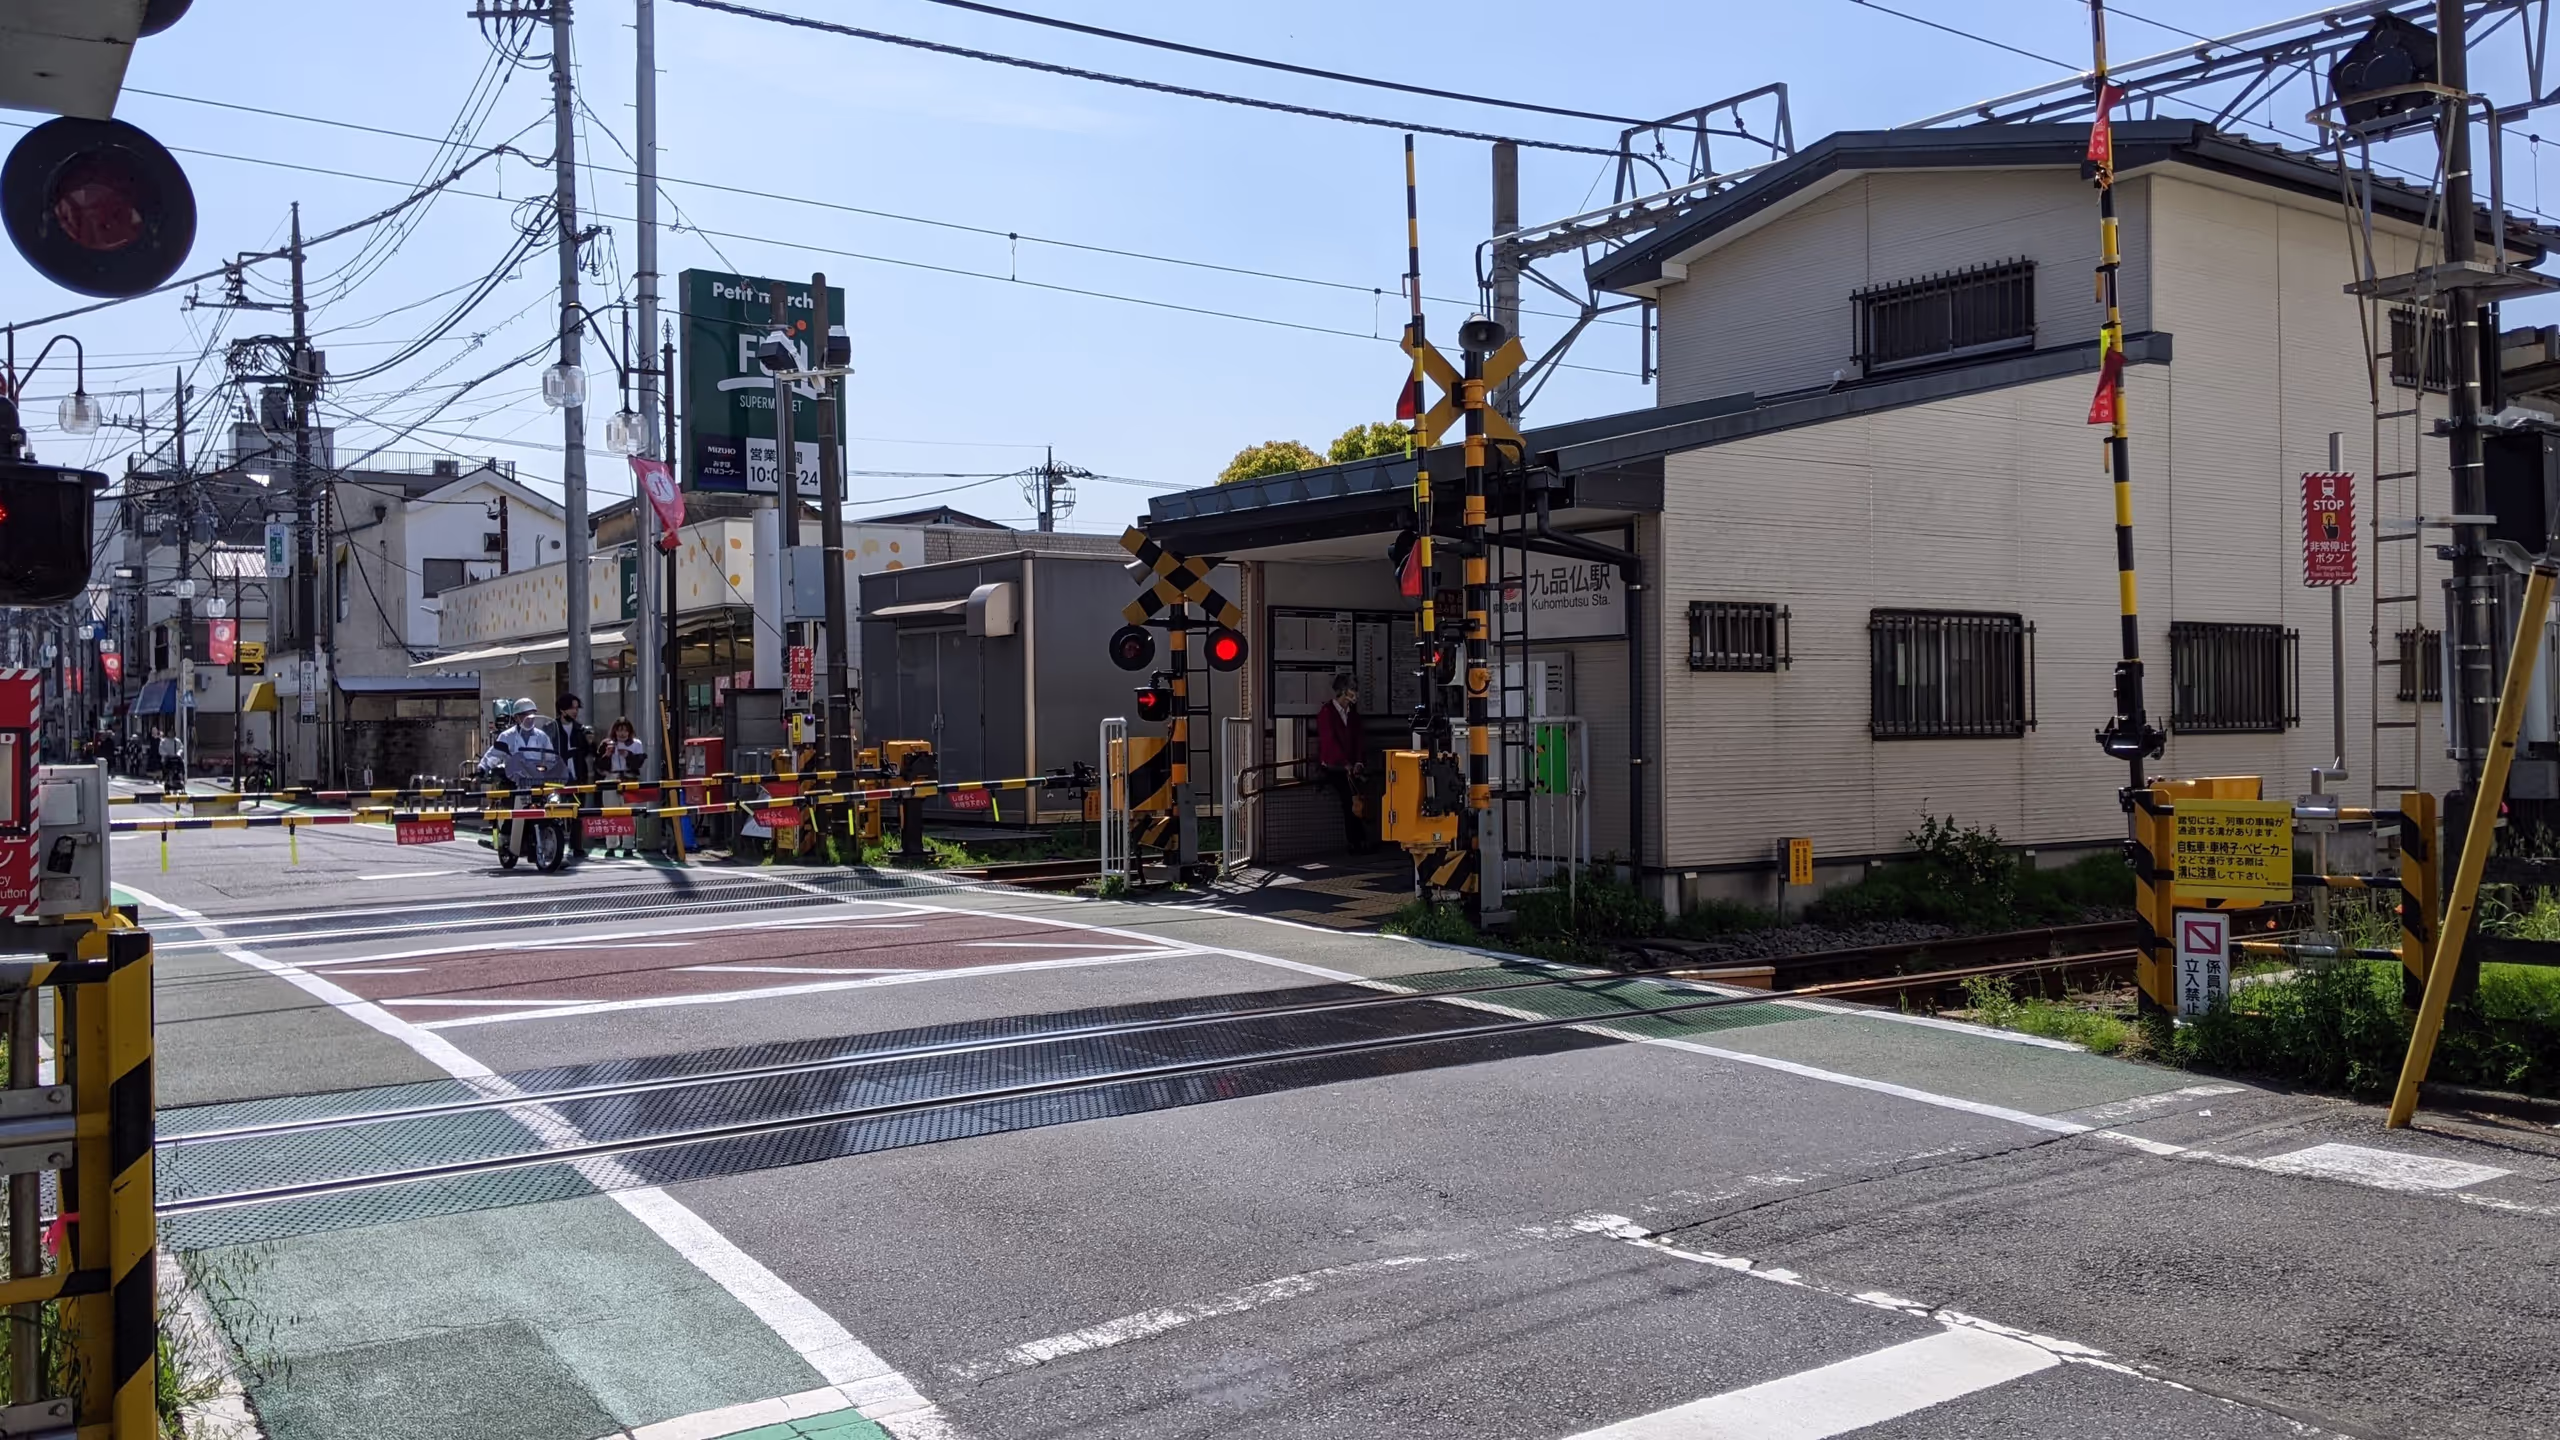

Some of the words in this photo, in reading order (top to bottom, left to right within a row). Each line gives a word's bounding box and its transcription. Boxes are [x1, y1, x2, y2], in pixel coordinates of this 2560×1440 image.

[758, 290, 814, 310] mrch
[739, 395, 803, 412] SUPERMET
[750, 447, 803, 465] 営業間
[2313, 499, 2345, 511] STOP
[2309, 541, 2351, 552] 非常停止
[2315, 554, 2345, 564] ボタン
[1529, 564, 1611, 596] 九品仏駅
[1531, 596, 1589, 611] Kuhombutsu
[1591, 594, 1611, 606] Sta.
[588, 825, 631, 833] お待ち下さい
[2178, 816, 2284, 827] 踏切には、列車の車輪が
[2178, 827, 2278, 837] 通過する溝があります。
[2178, 866, 2269, 881] 溝に注意して下さい。
[2184, 958, 2200, 1016] 立入禁止
